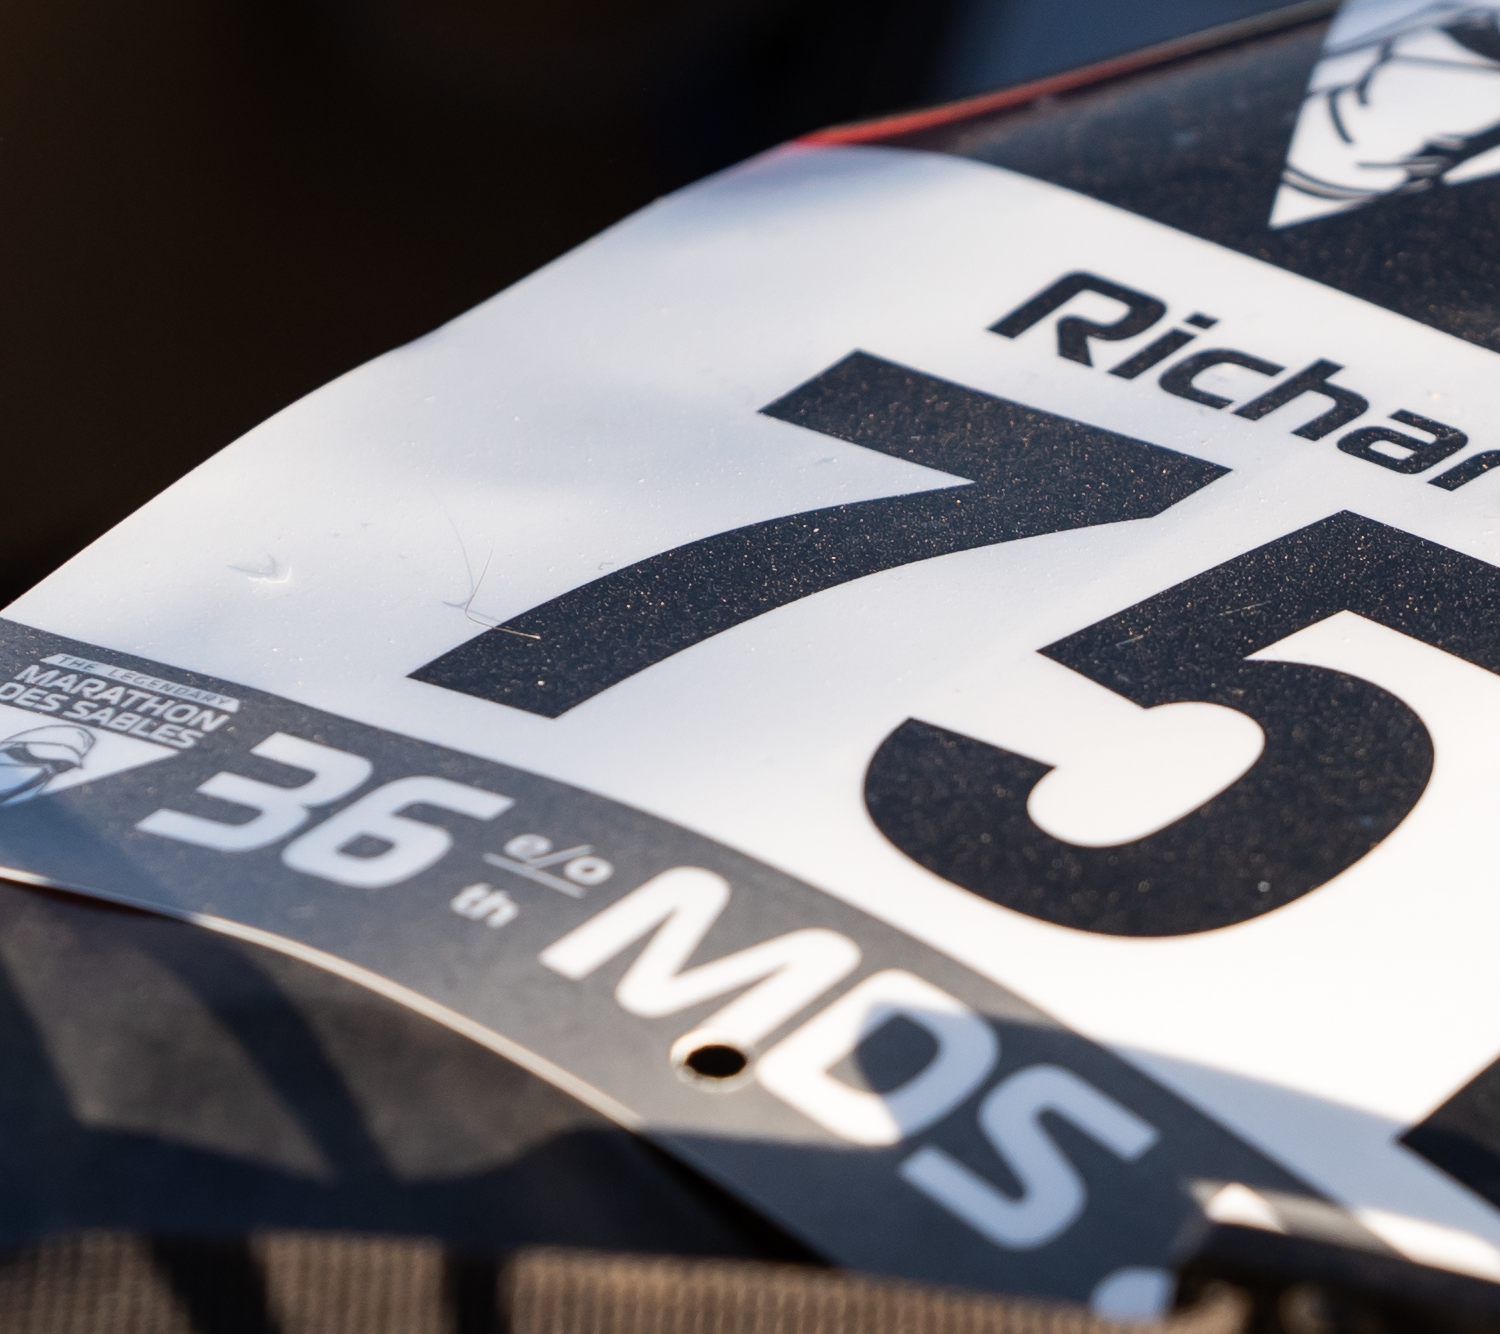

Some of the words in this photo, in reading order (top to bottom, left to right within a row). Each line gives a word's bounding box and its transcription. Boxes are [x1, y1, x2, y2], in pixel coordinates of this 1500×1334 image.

[13, 663, 232, 734] MARATHON
[58, 654, 100, 673] THE
[108, 666, 232, 708] LEGENDARY
[61, 699, 206, 750] SABLES
[134, 731, 516, 889] 36
[449, 881, 521, 930] th
[538, 867, 1162, 1252] MDS
